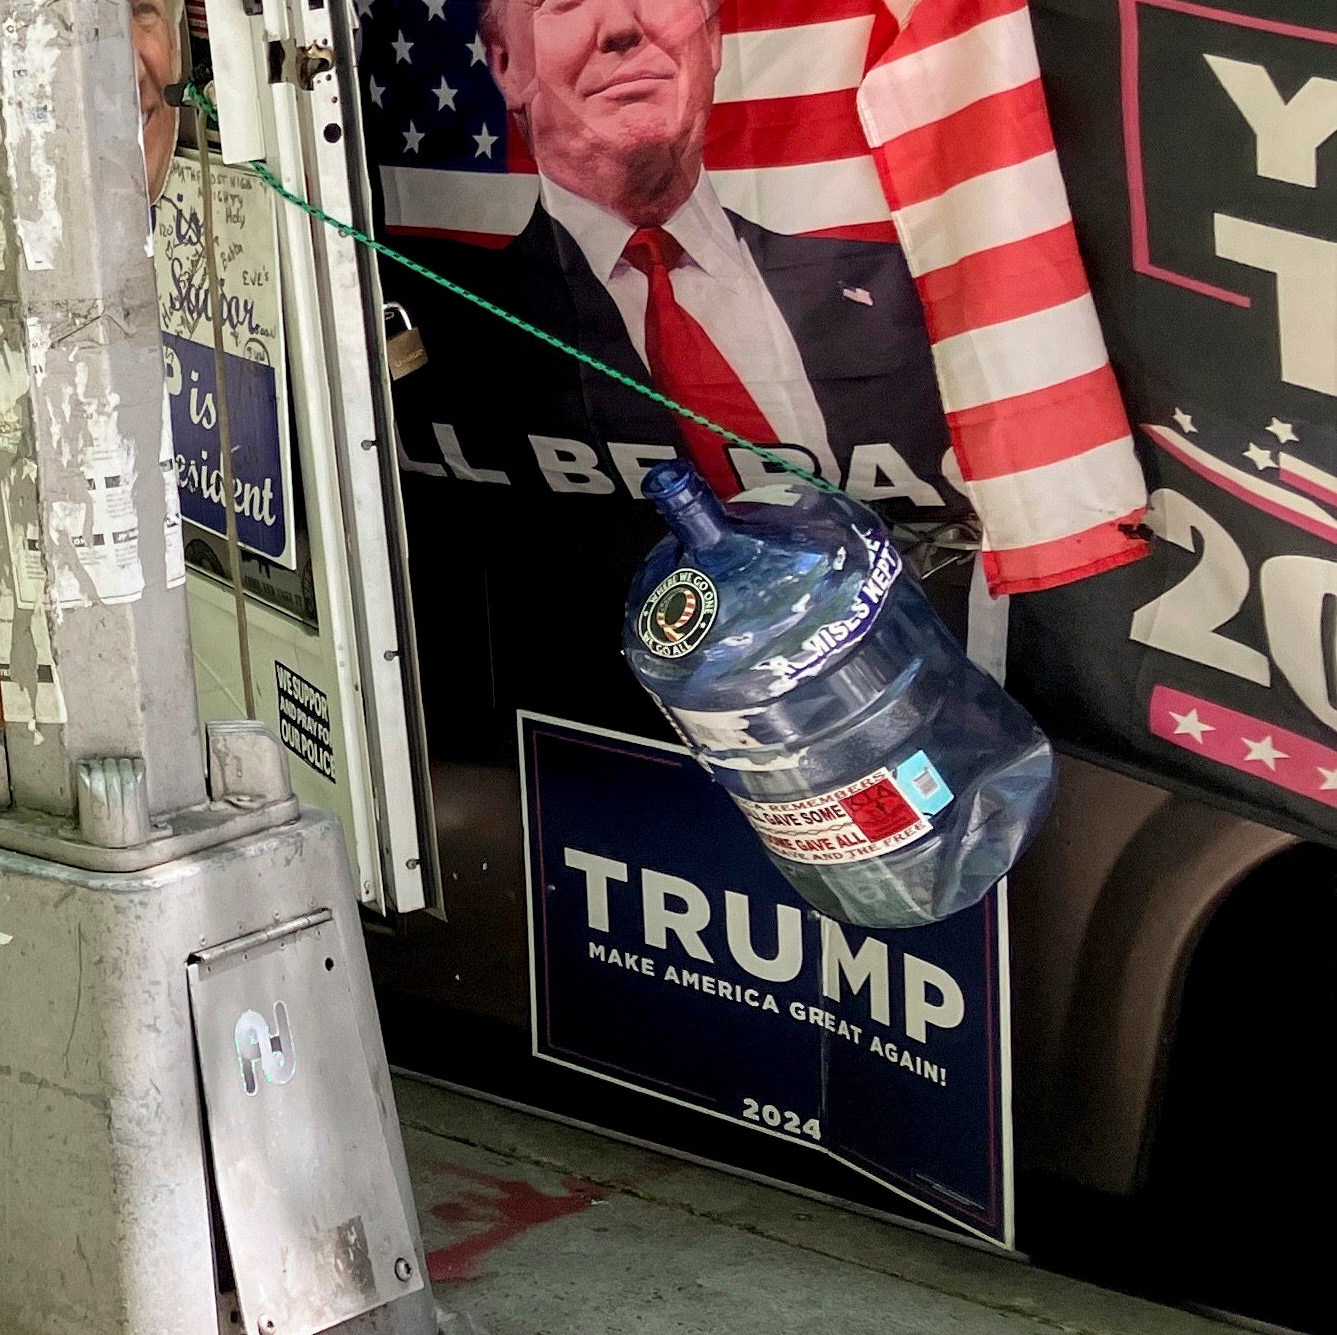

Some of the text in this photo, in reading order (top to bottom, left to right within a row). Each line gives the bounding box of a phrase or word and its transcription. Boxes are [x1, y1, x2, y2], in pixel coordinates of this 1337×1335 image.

[189, 371, 218, 430] is
[679, 572, 694, 583] WE
[693, 575, 709, 591] GO
[704, 592, 715, 615] ONE
[862, 550, 903, 605] KEPT
[280, 696, 297, 721] AND
[281, 718, 301, 750] OUR
[773, 770, 887, 814] REMEMBERS
[767, 803, 847, 831] GAVE SOME
[883, 822, 925, 851] FREE
[795, 830, 867, 853] GAVE ALL
[564, 847, 966, 1044] TRUMP
[587, 941, 948, 1087] MAKE AMERICA GREAT AGAIN!
[741, 1098, 822, 1142] 2024
